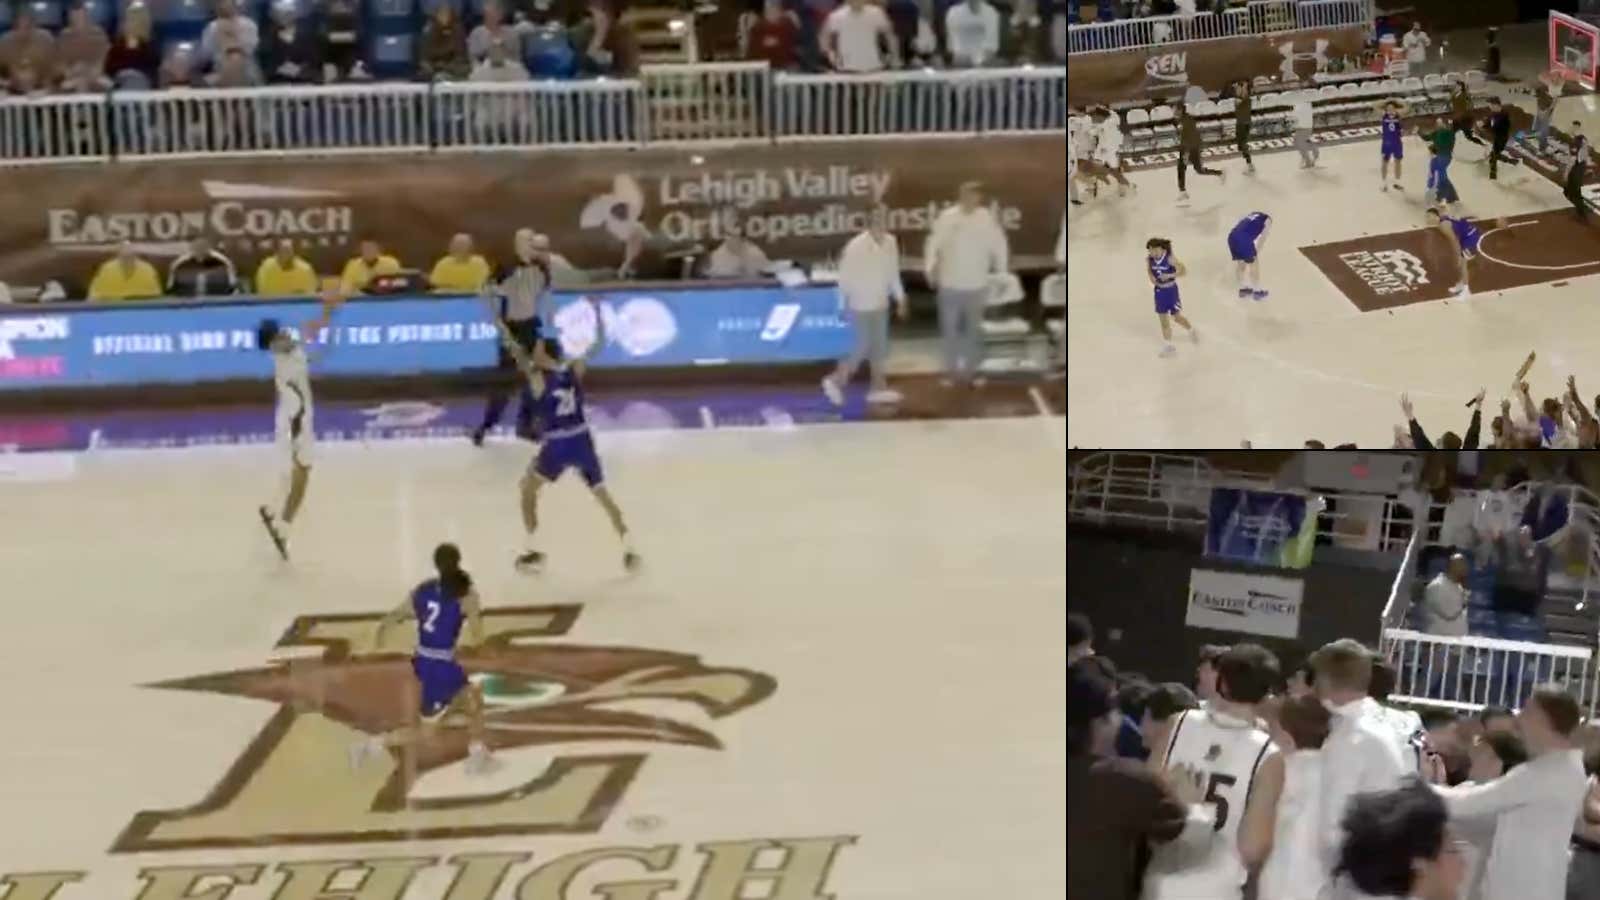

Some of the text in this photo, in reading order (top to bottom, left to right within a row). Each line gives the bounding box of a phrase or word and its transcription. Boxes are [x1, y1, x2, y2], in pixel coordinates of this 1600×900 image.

[660, 166, 891, 208] Lehigh Valley
[48, 200, 351, 243] EASTON COACH
[877, 198, 1022, 231] Instte
[423, 600, 441, 632] 2
